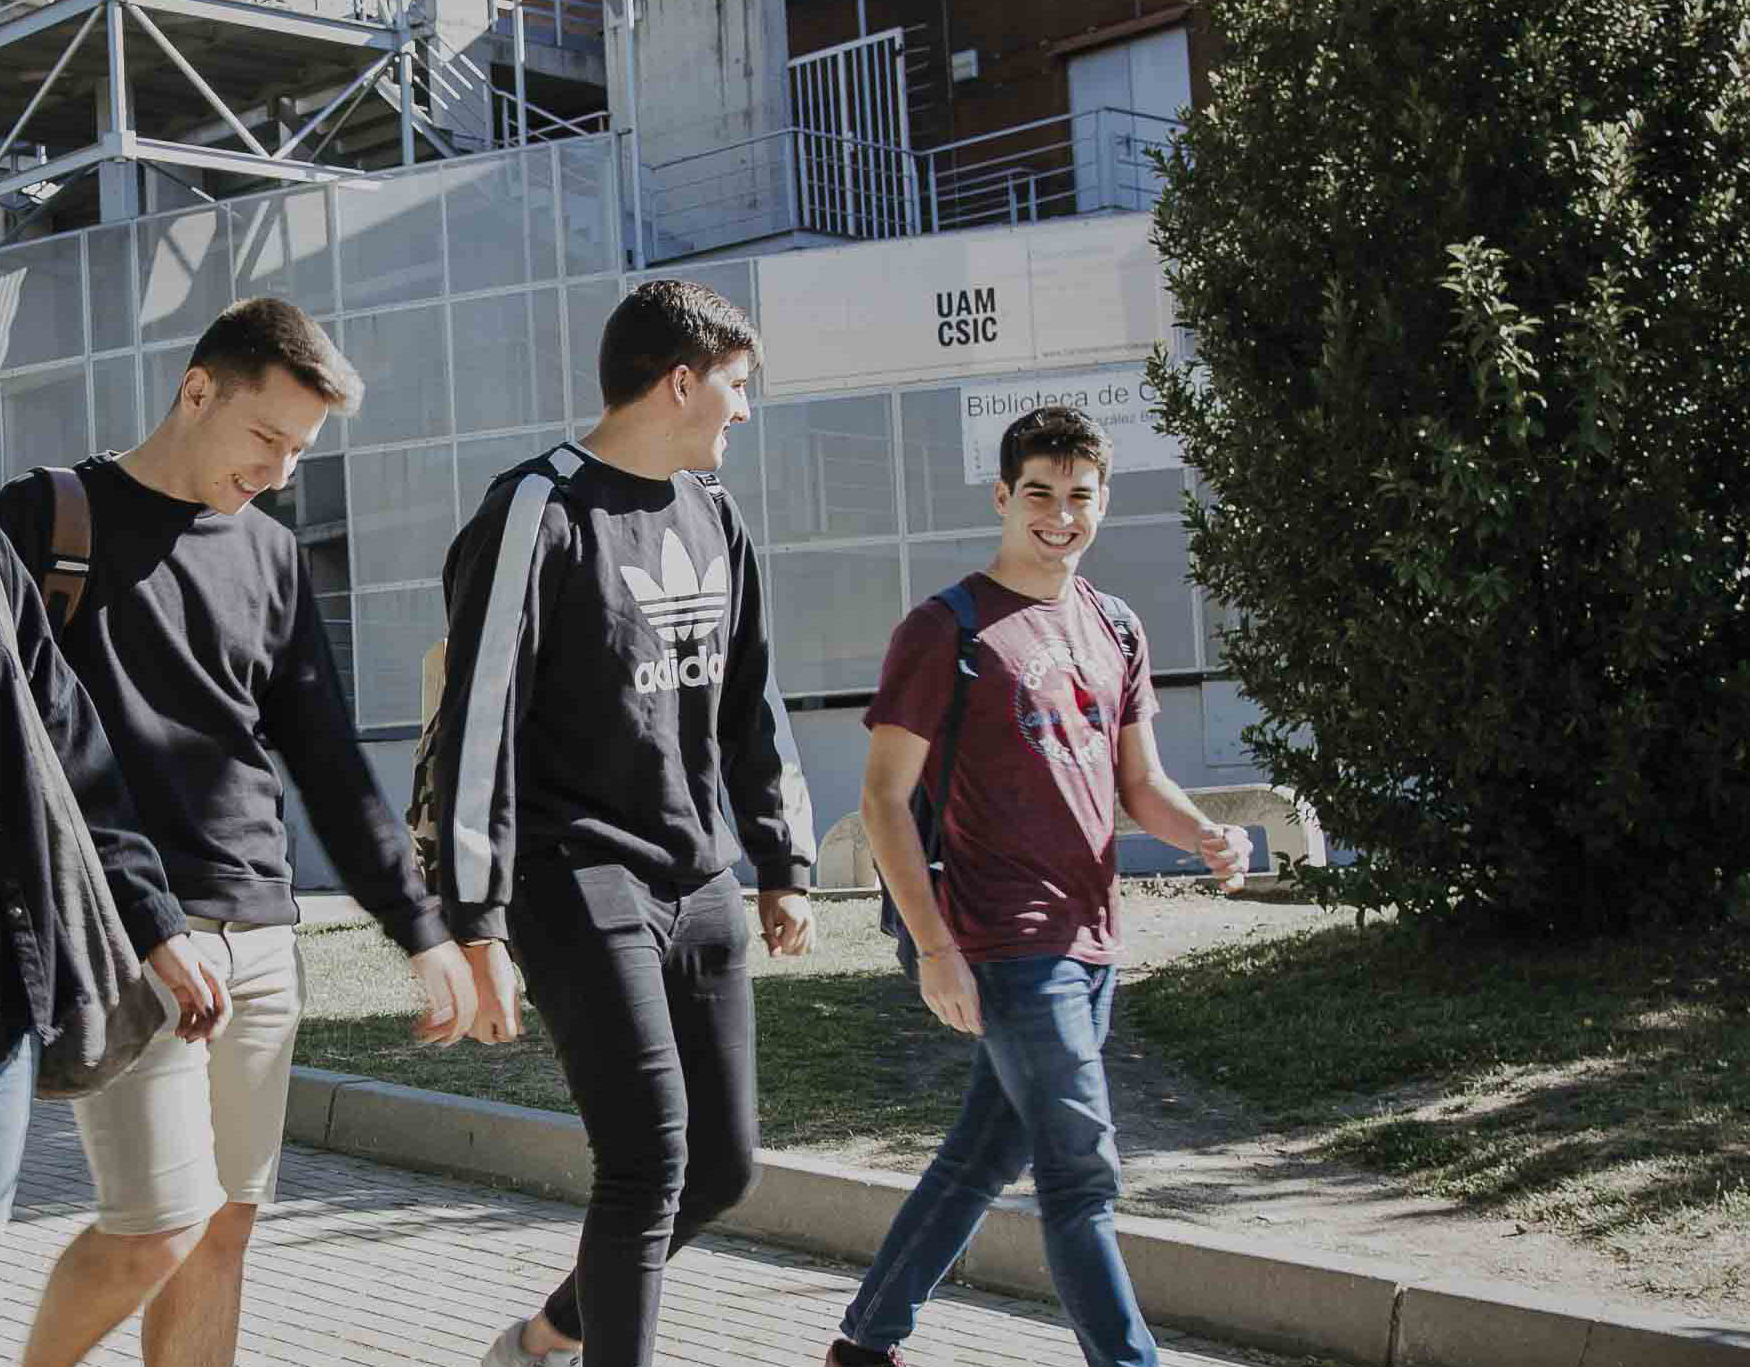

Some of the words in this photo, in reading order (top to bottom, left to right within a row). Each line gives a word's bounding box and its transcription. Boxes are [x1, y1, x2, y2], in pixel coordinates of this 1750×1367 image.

[937, 288, 996, 318] UAM
[938, 317, 998, 347] CSIC
[967, 389, 1089, 418] Biblioteca
[1099, 384, 1129, 405] de
[634, 645, 724, 694] adida
